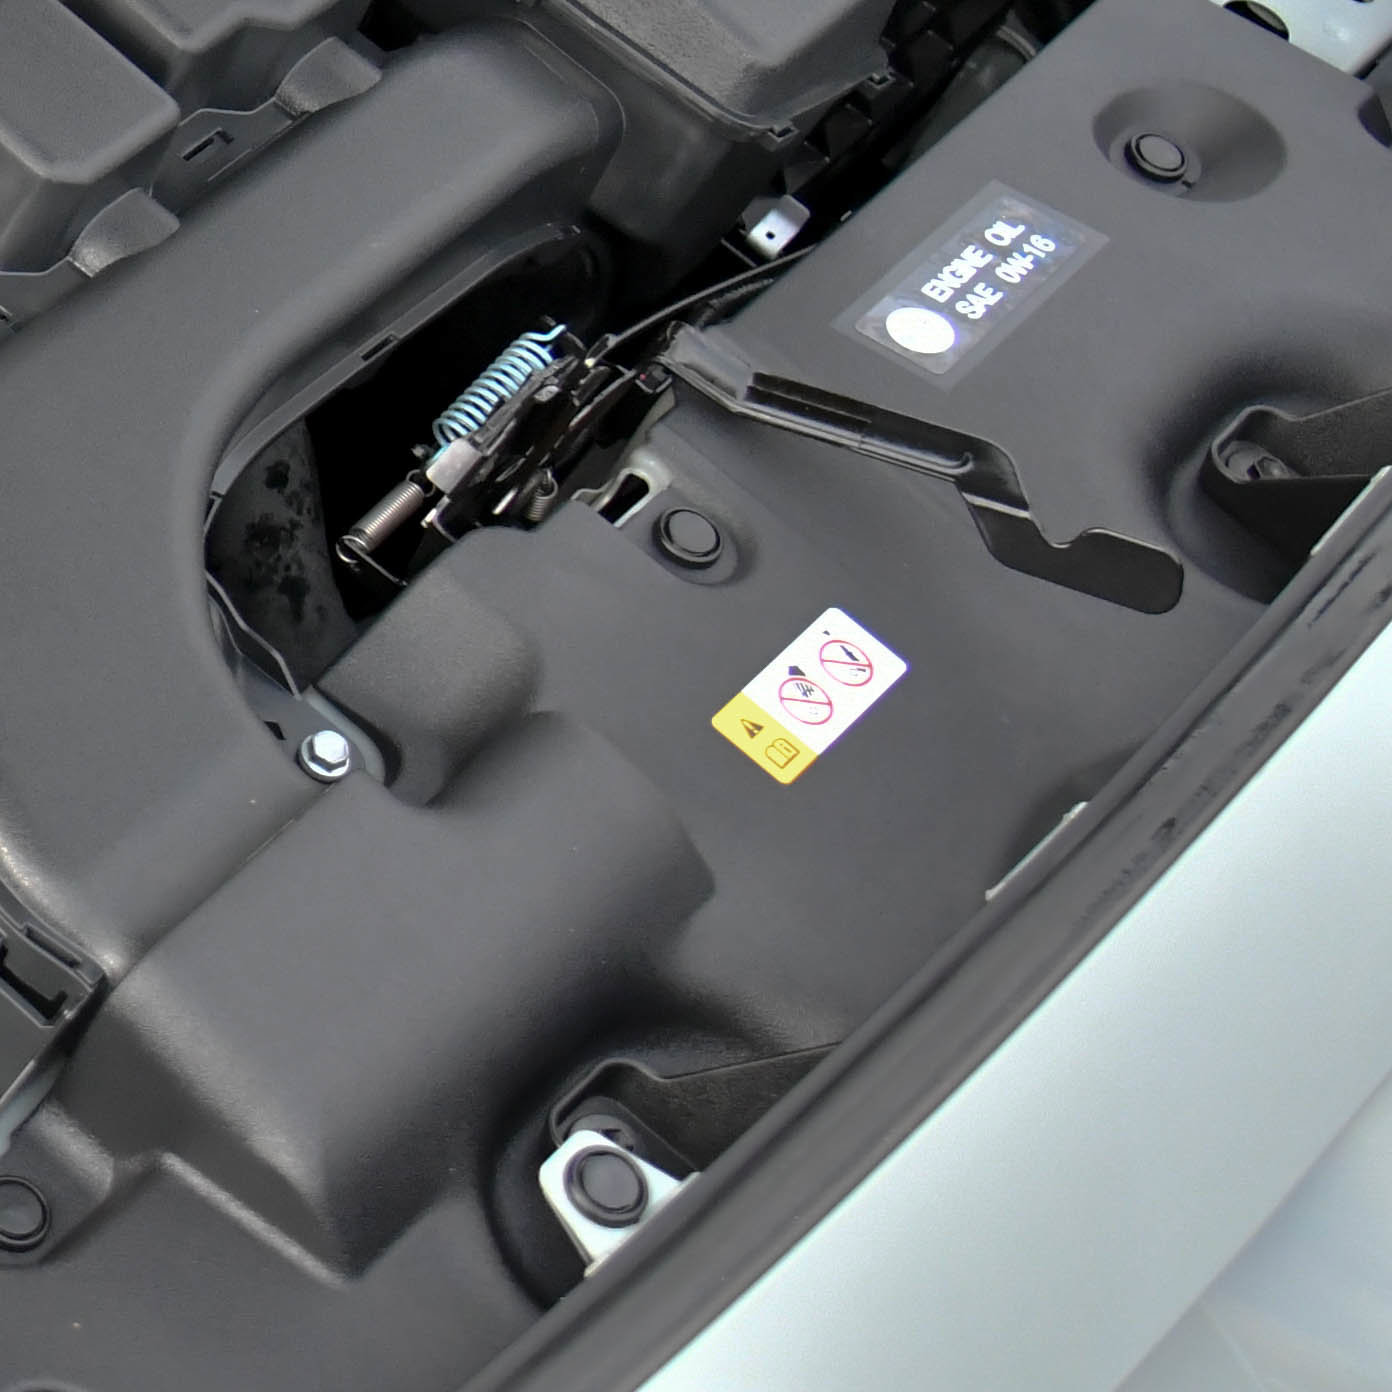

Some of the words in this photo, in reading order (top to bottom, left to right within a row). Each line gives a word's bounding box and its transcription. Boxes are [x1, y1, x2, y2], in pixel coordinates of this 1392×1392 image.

[921, 245, 993, 303] ENGINE
[955, 282, 1003, 319] SAE
[995, 234, 1056, 284] 0W-16
